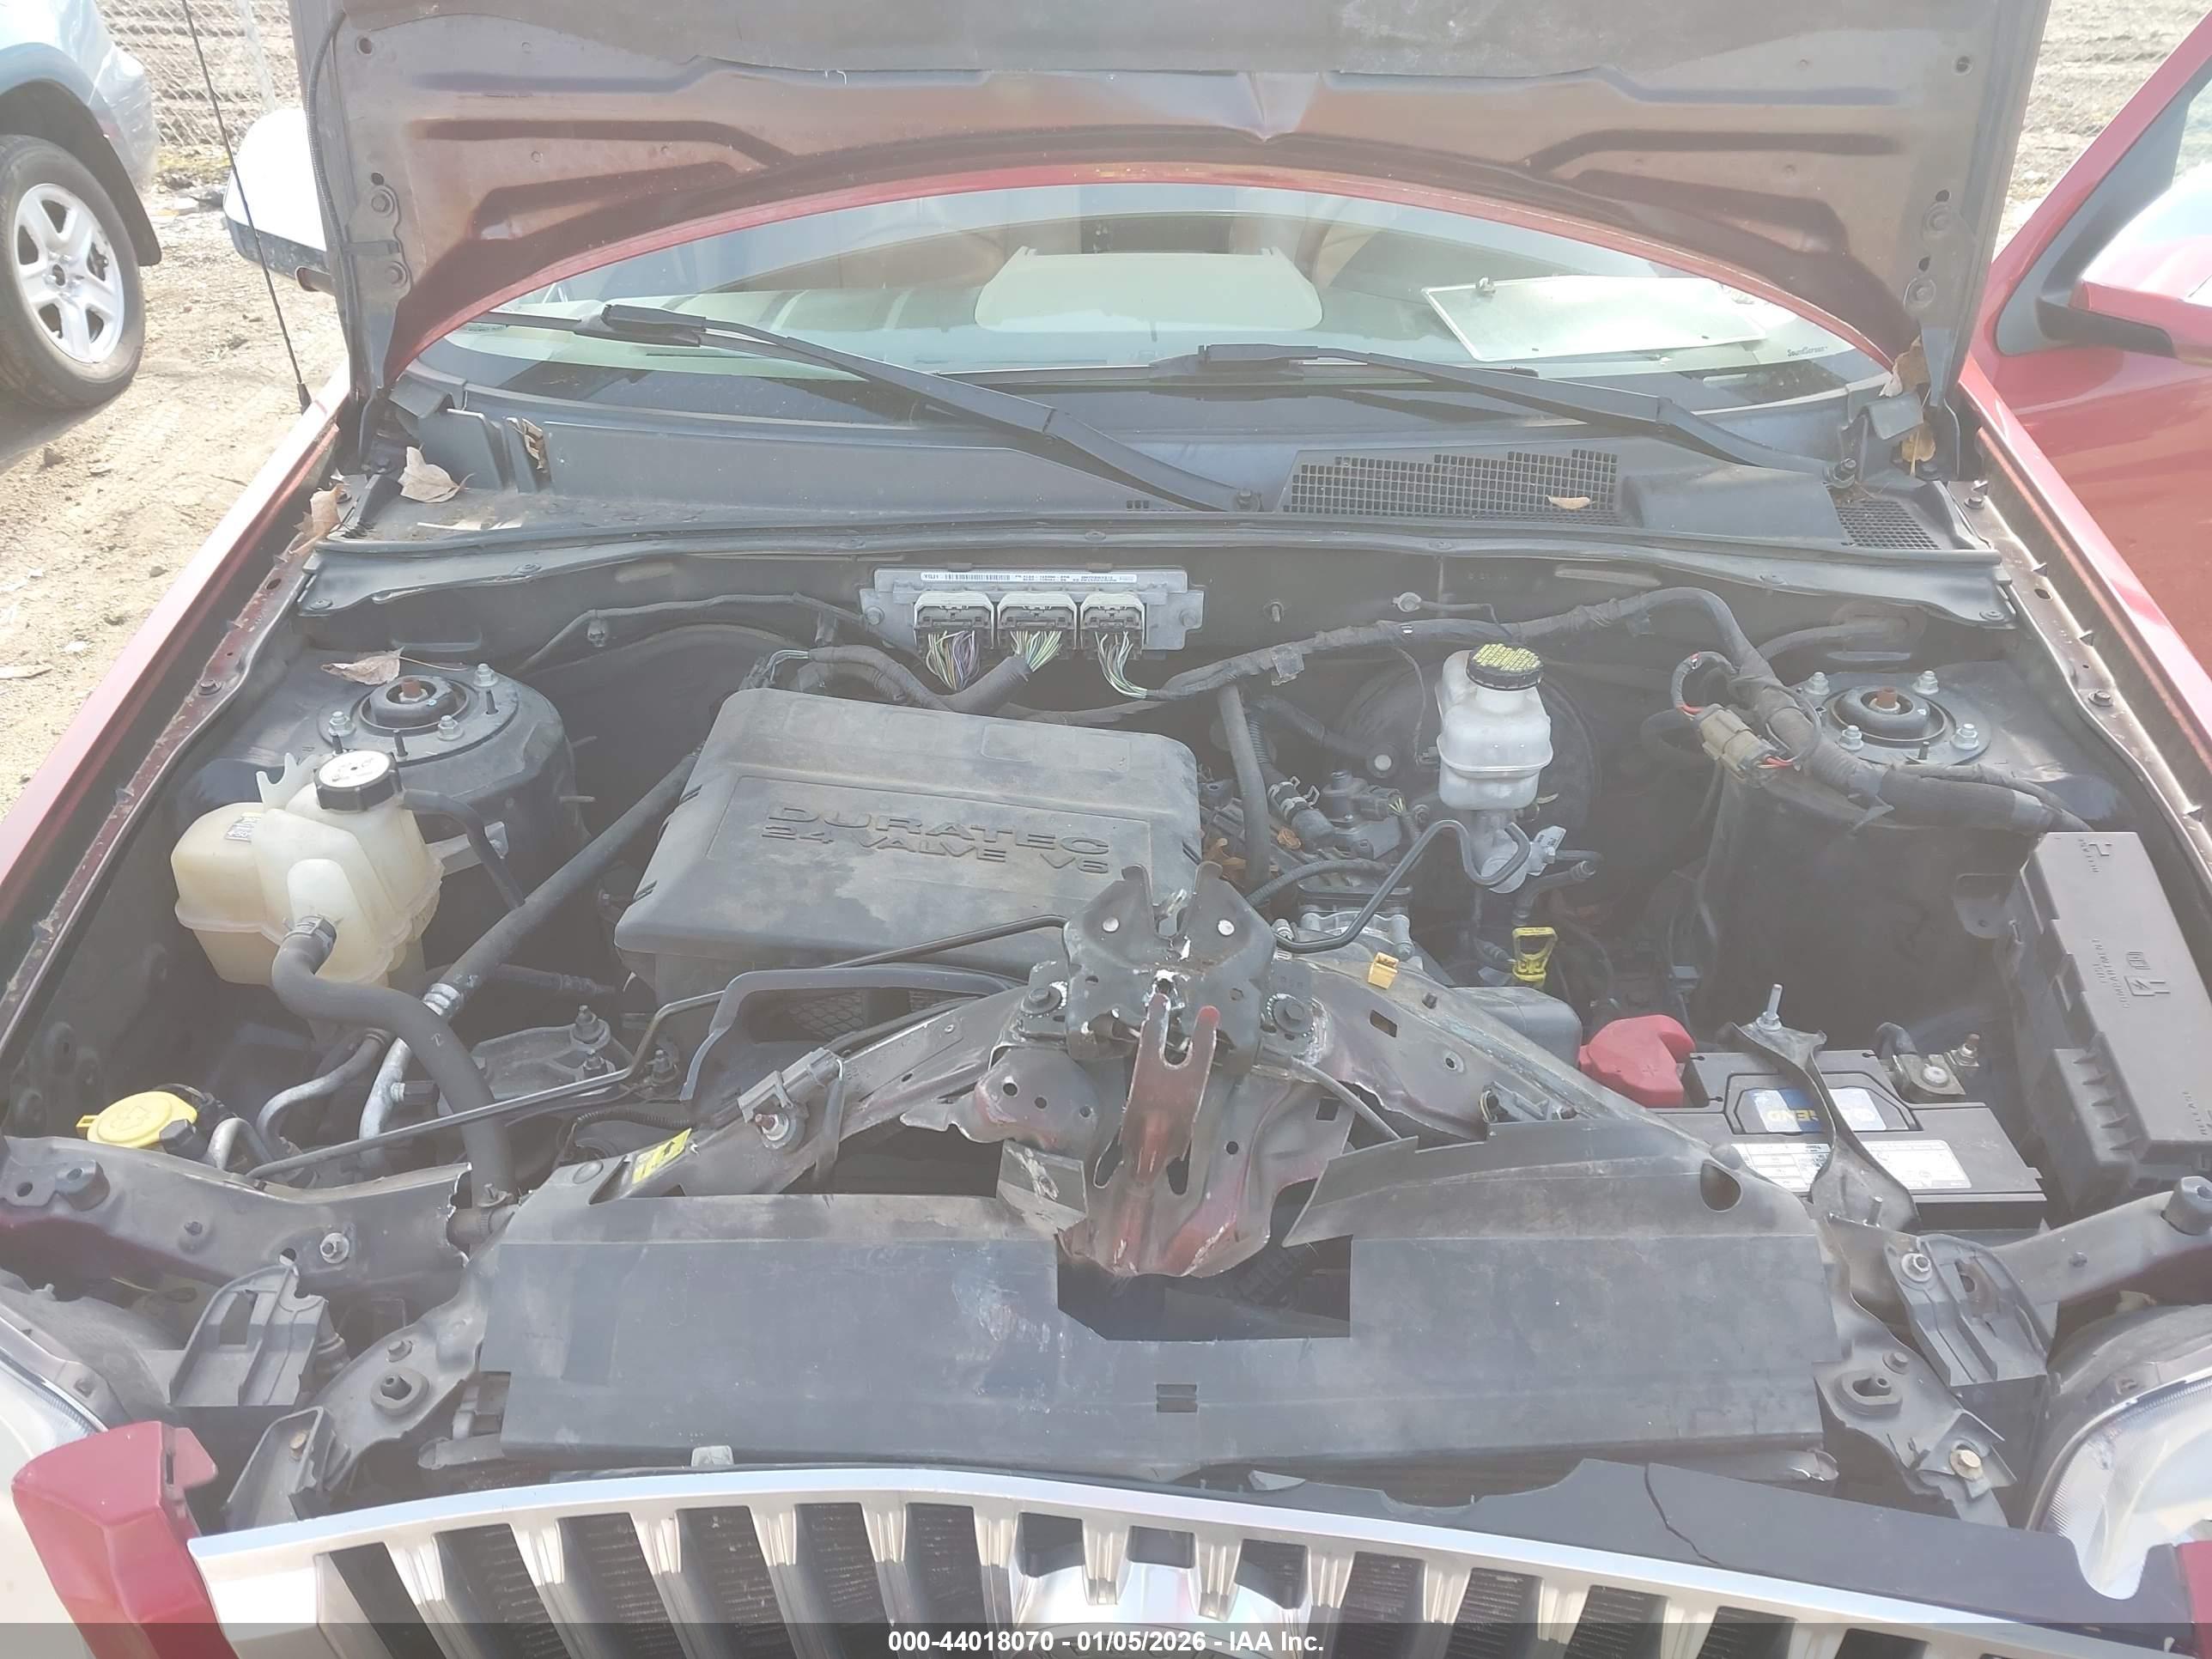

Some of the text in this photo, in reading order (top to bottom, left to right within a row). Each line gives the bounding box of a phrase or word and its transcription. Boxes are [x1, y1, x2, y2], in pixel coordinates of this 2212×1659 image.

[762, 825, 1110, 875] 24 VALVE V6
[768, 806, 1110, 855] DURATEC
